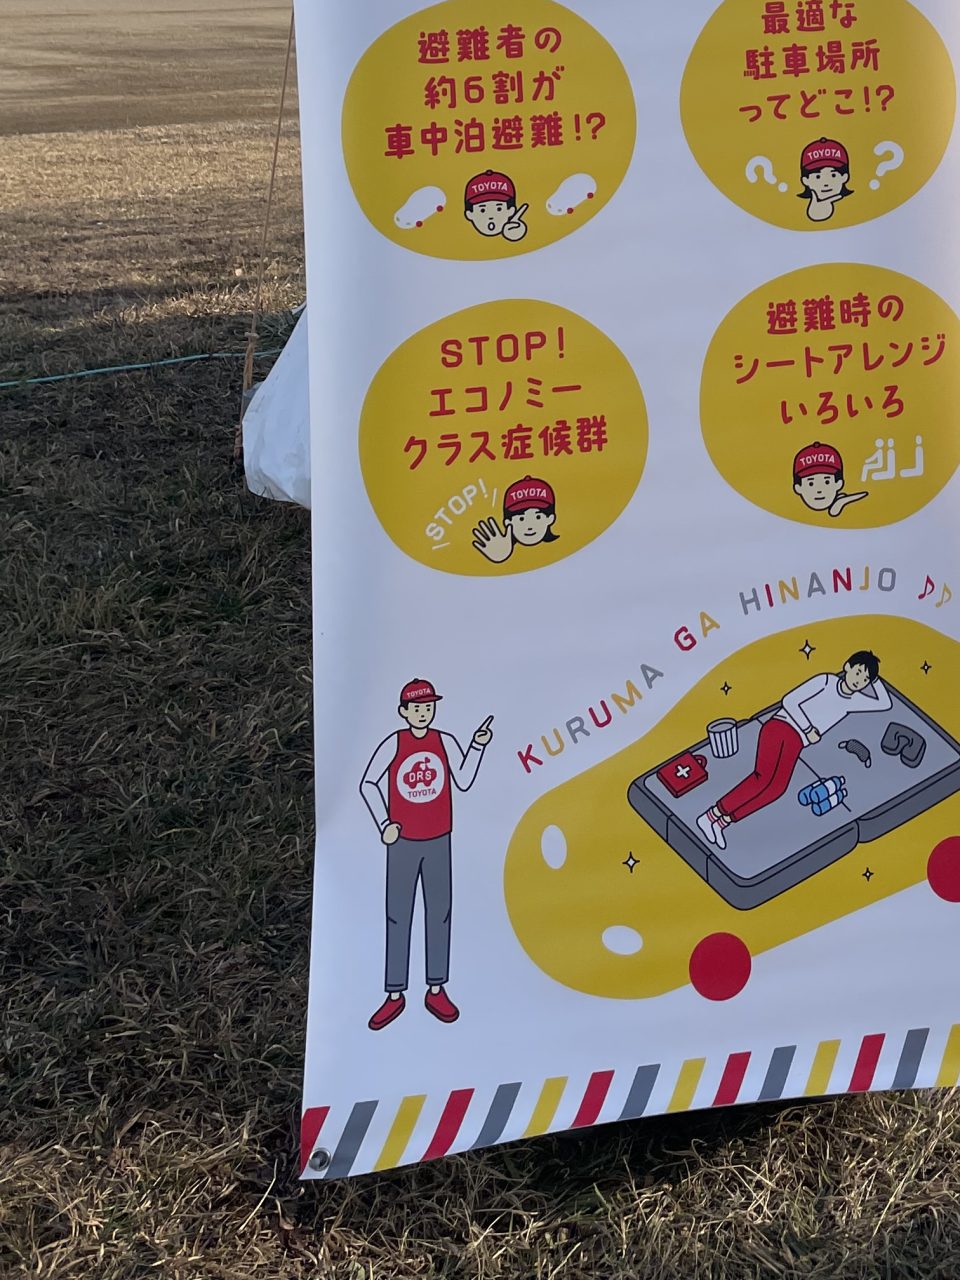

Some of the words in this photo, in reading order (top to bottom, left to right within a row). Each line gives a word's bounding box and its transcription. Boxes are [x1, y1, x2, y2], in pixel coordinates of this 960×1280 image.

[417, 24, 563, 64] 避難者の
[743, 38, 882, 81] 駐車場所
[424, 64, 566, 110] 約6割が
[739, 84, 896, 123] ってどこ!?
[384, 112, 607, 159] 車中泊避難!?
[807, 148, 843, 160] TOYOTA
[472, 180, 508, 194] TOYOTA
[766, 293, 904, 335] 避難時の
[441, 326, 567, 369] STOP!
[733, 333, 947, 384] シートアレンジ
[429, 377, 582, 418] エコノミー
[780, 384, 905, 426] いろいろ
[404, 415, 609, 470] クラス症候群
[799, 453, 836, 466] TOYOTA
[425, 479, 488, 543] STOP!
[510, 487, 547, 500] TOYOTA
[516, 663, 664, 774] KURUMA
[674, 611, 721, 652] GA
[739, 566, 897, 615] HINANJO
[406, 687, 431, 698] TOYOTA
[407, 788, 437, 799] TOYOTA
[408, 770, 432, 783] DRS
